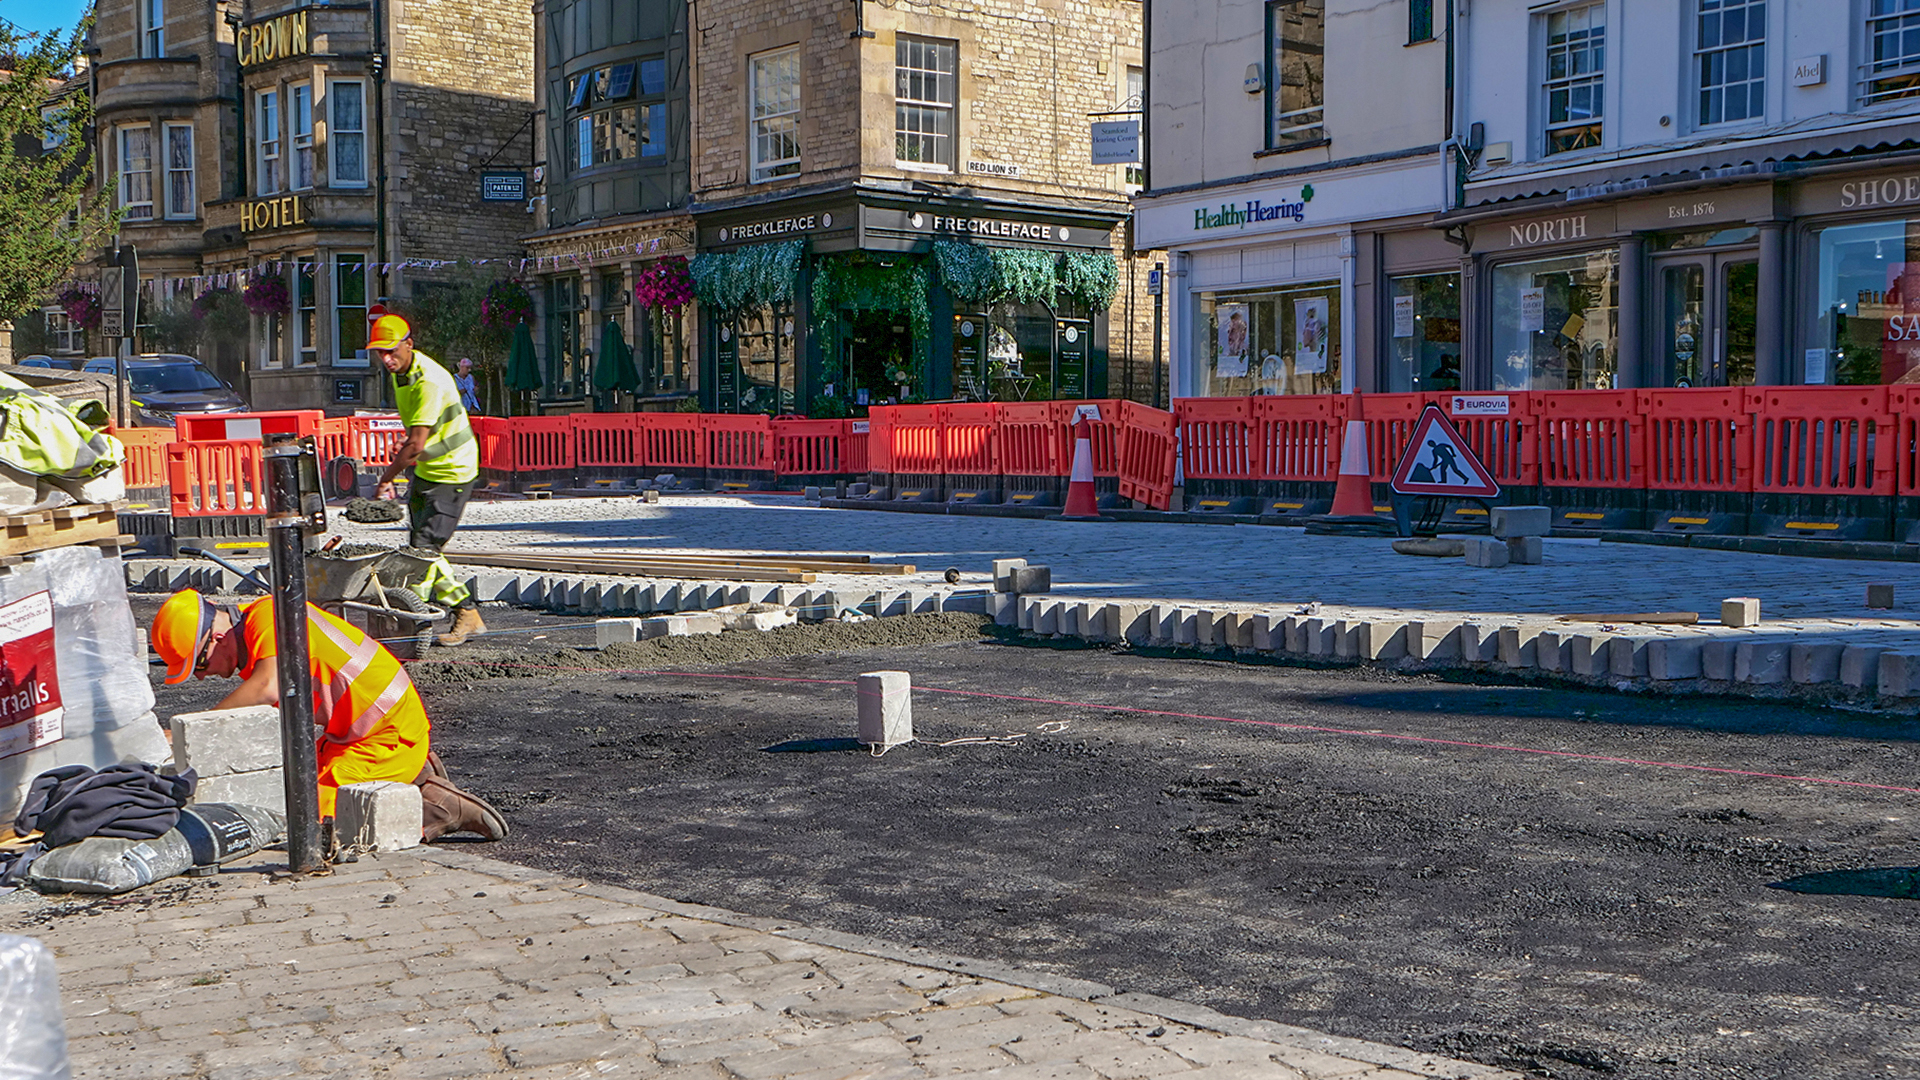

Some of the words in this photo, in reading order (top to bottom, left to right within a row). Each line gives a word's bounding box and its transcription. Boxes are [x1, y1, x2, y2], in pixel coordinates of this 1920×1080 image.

[237, 10, 307, 67] CROWN
[1794, 63, 1819, 79] Abel
[970, 162, 986, 171] RED
[987, 164, 1006, 174] LION
[1841, 176, 1920, 208] SHOE
[240, 195, 304, 233] HOTEL
[1194, 198, 1304, 230] HealthyHearing
[1668, 206, 1689, 219] Est.
[1693, 201, 1715, 216] 1876
[731, 214, 815, 239] FRECKLEFACE
[934, 216, 1051, 239] FRECKLEFACE
[1509, 215, 1587, 246] NORTH
[104, 326, 120, 335] ENDS
